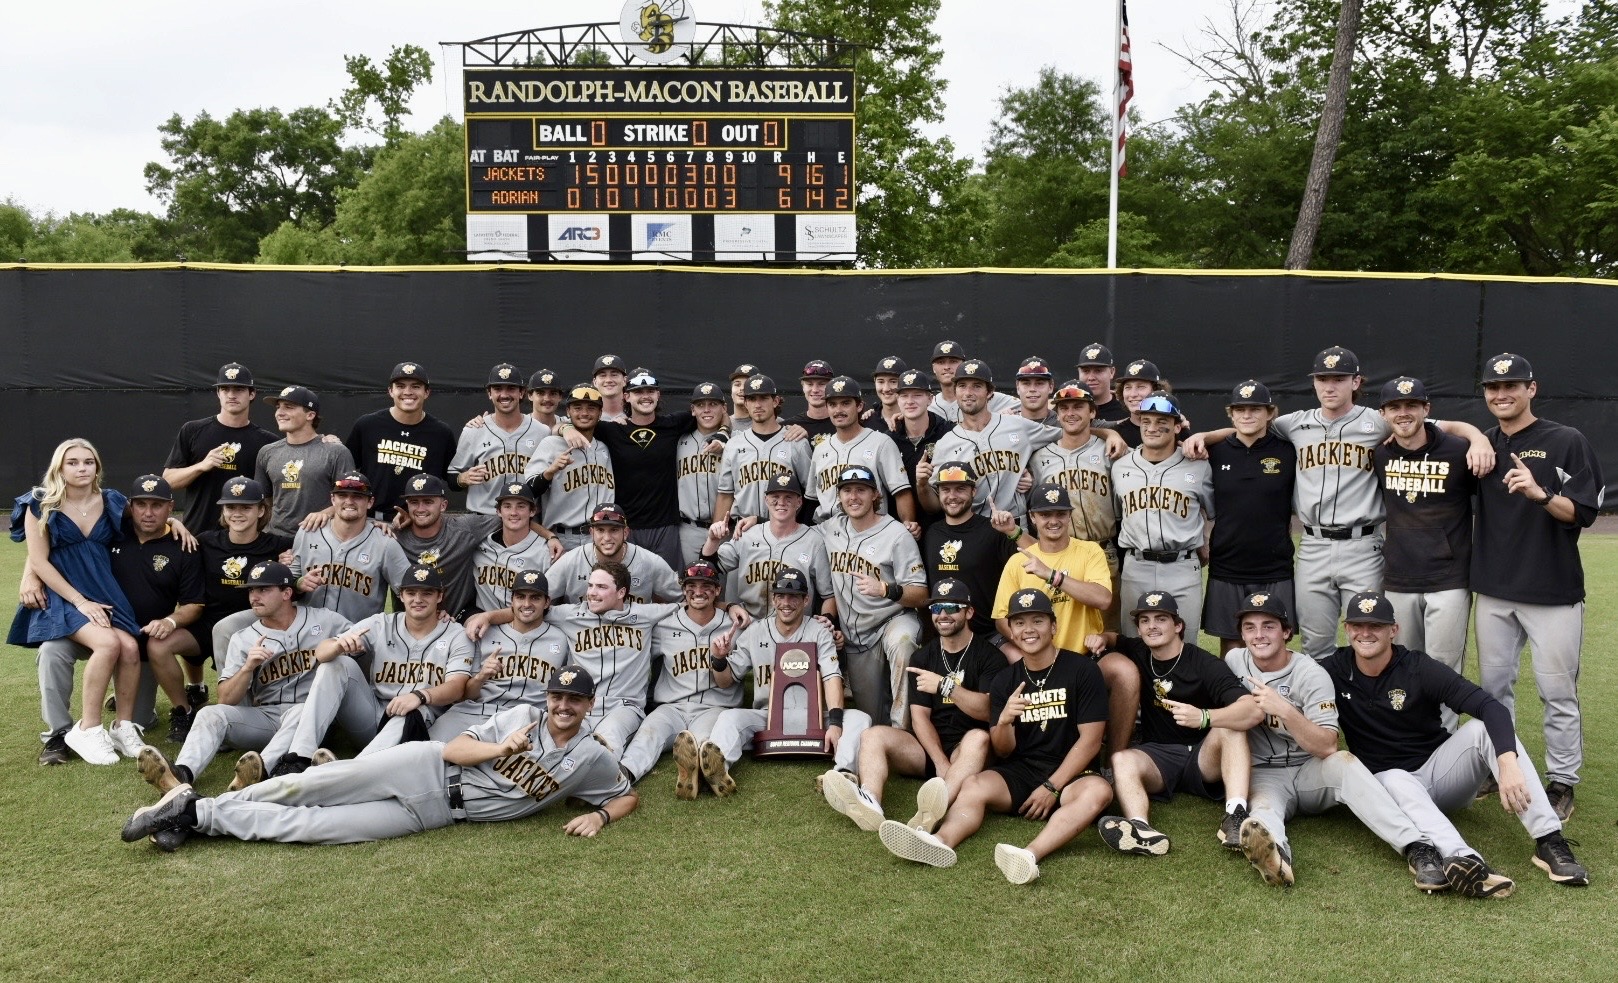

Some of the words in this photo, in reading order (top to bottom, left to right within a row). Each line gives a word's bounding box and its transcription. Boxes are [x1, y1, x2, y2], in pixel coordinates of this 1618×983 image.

[469, 80, 723, 103] RANDOLPH-MACON
[728, 80, 848, 103] BASEBALL
[539, 124, 587, 142] BALL
[623, 124, 688, 142] STRIKE
[721, 124, 759, 142] OUT
[469, 149, 486, 163] AT
[493, 149, 520, 163] BAT
[569, 151, 576, 163] 1
[588, 151, 597, 163] 2
[608, 151, 616, 163] 3
[627, 151, 636, 163] 4
[647, 151, 655, 163] 5
[666, 151, 675, 163] 6
[686, 151, 694, 163] 7
[705, 151, 714, 163] 8
[725, 151, 734, 163] 9
[742, 151, 756, 163] 10
[773, 151, 782, 163] R
[807, 151, 816, 163] H
[838, 151, 846, 163] E
[483, 167, 545, 181] JACKETS
[575, 164, 579, 184] 1
[586, 164, 598, 184] 5
[606, 164, 618, 184] 0
[626, 164, 638, 184] 0
[646, 164, 658, 184] 0
[665, 164, 677, 184] 0
[685, 164, 697, 184] 3
[704, 164, 716, 184] 0
[724, 164, 736, 184] 0
[779, 164, 791, 184] 9
[806, 164, 824, 184] 16
[844, 164, 848, 184] 1
[491, 190, 539, 204] ADRIAN
[568, 188, 580, 208] 0
[595, 188, 599, 208] 1
[607, 188, 619, 208] 0
[635, 188, 638, 208] 1
[654, 188, 658, 208] 1
[665, 188, 677, 208] 0
[685, 188, 697, 208] 0
[704, 188, 716, 208] 0
[724, 188, 736, 208] 3
[779, 188, 791, 208] 6
[806, 188, 824, 208] 14
[836, 188, 848, 208] 2
[558, 227, 601, 240] ARC3
[377, 438, 428, 458] JACKETS
[1299, 440, 1376, 472] JACKETS
[377, 452, 423, 471] BASEBALL
[484, 453, 531, 482] JACKE
[974, 450, 1020, 477] CKETS
[1385, 459, 1450, 475] JACKETS
[1385, 476, 1446, 493] BASEBALL
[575, 623, 643, 653] JACKETS
[259, 649, 317, 684] JACKE
[672, 647, 712, 677] JACK
[782, 661, 809, 670] NCAA
[375, 661, 444, 687] JACKETS
